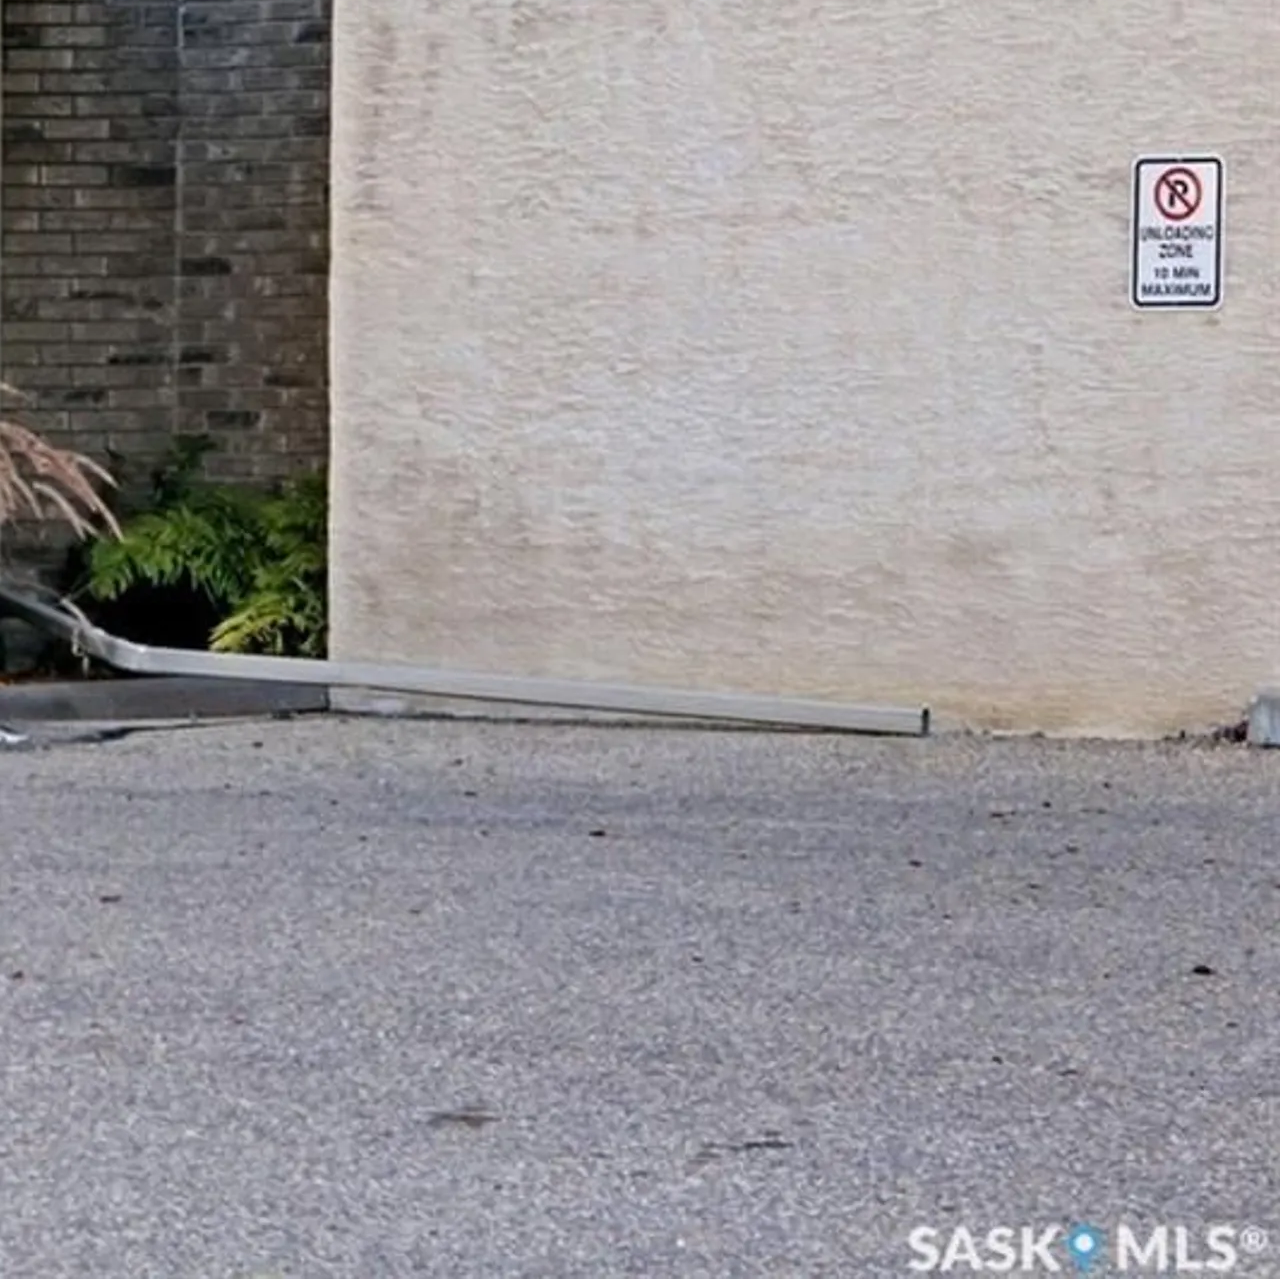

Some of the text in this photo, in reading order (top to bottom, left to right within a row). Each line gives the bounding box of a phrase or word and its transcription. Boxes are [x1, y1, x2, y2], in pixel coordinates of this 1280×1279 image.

[1140, 225, 1214, 241] UNLOADING
[1158, 243, 1194, 259] ZONE
[1154, 267, 1200, 280] 10 MIN
[1141, 283, 1211, 297] MAXIMUM
